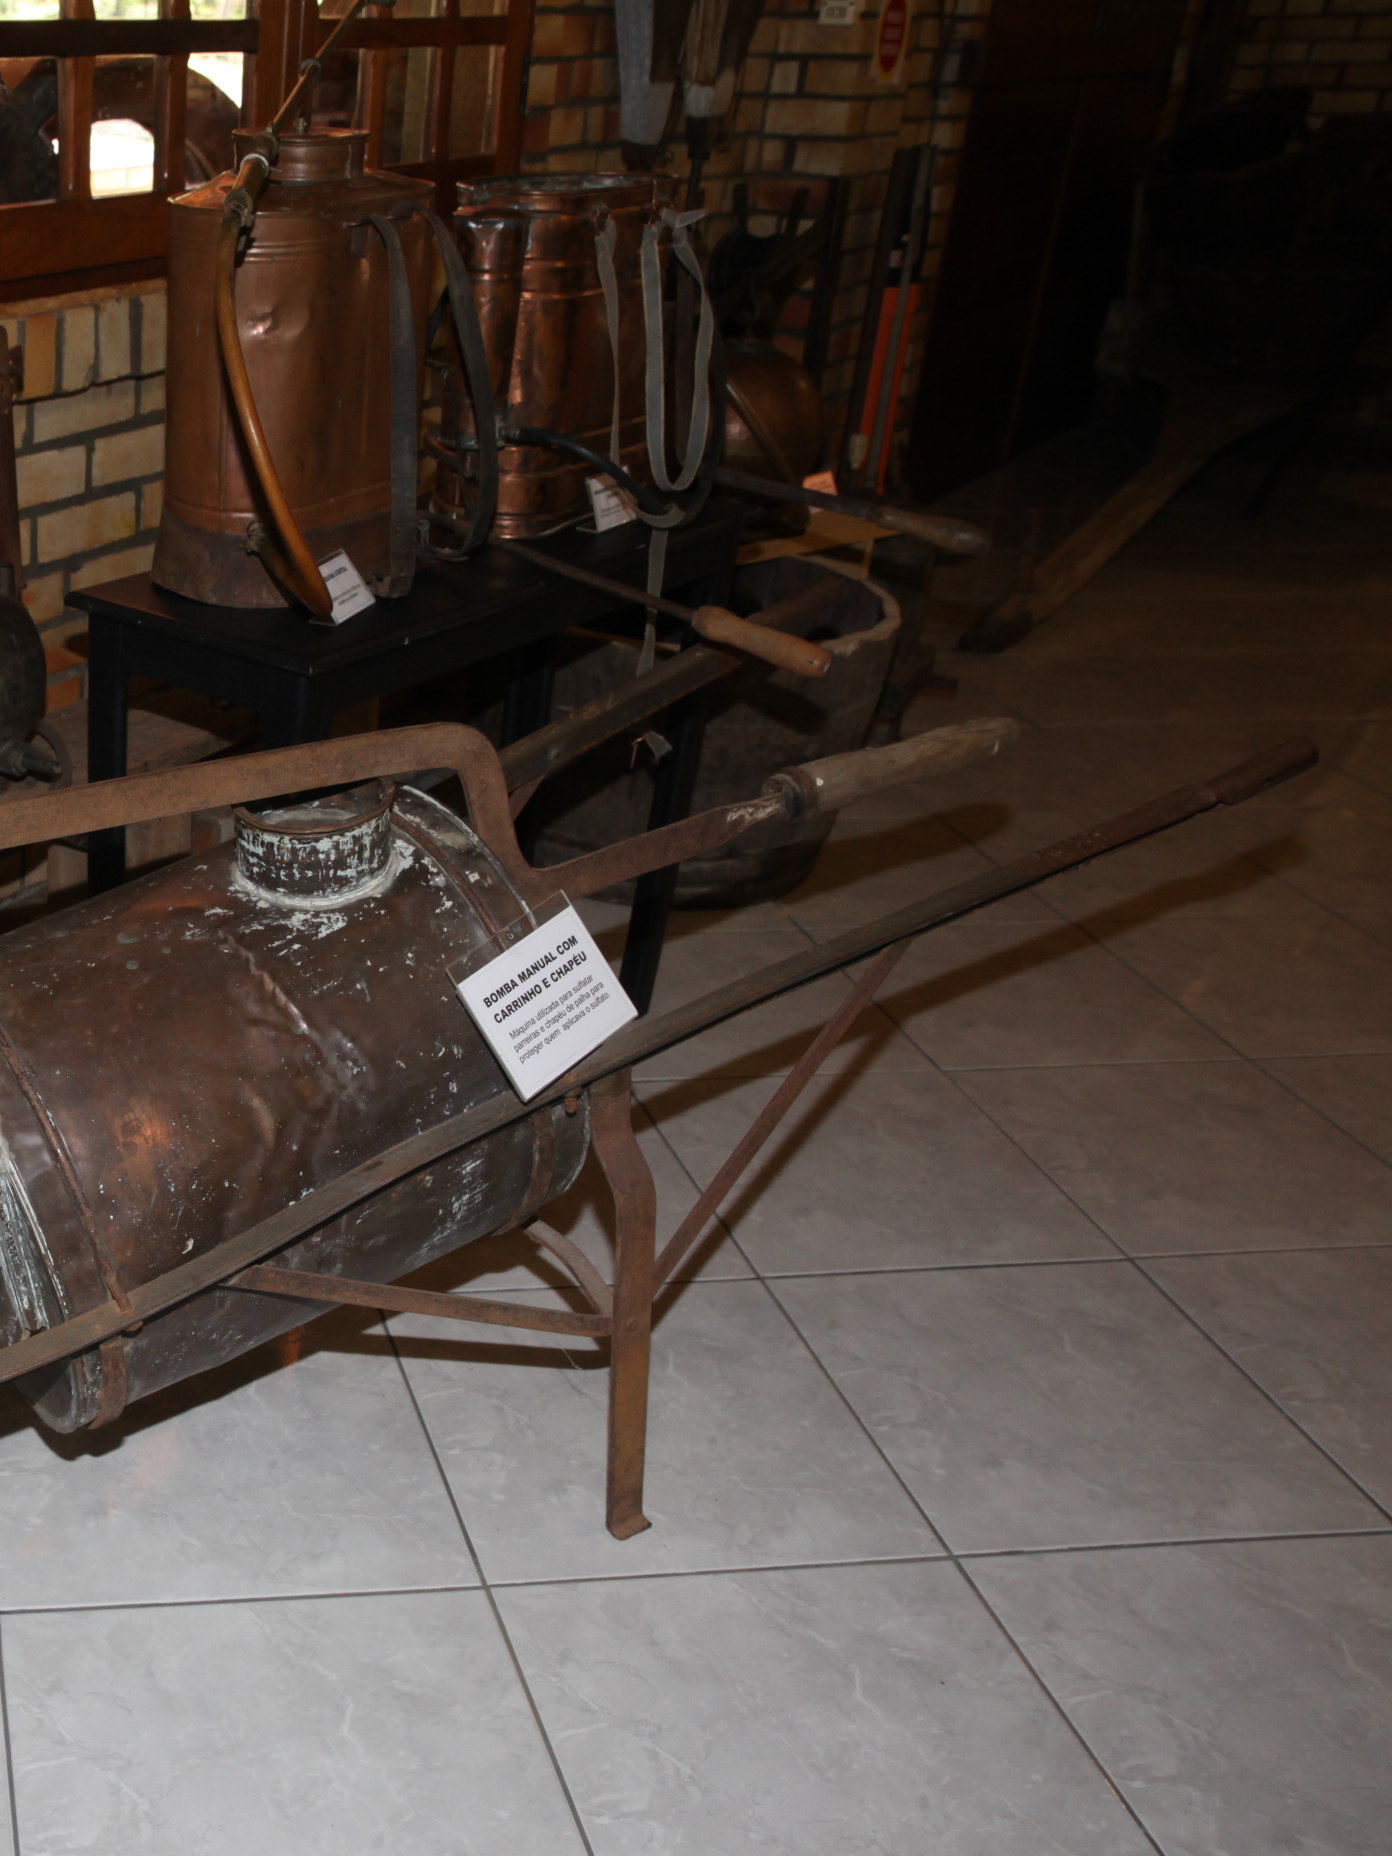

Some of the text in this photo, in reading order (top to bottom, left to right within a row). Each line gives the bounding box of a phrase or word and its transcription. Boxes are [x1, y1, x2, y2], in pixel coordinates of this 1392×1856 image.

[483, 935, 578, 1008] BOMBA MANUAL COM
[494, 951, 587, 1023] CARRINHO E CHAPÉU
[509, 974, 594, 1040] Máquina utilizada para sulfatar
[514, 981, 605, 1054] parreiras e chapéu de palha para
[519, 992, 611, 1065] proteger quem aplicava o sulfato.
